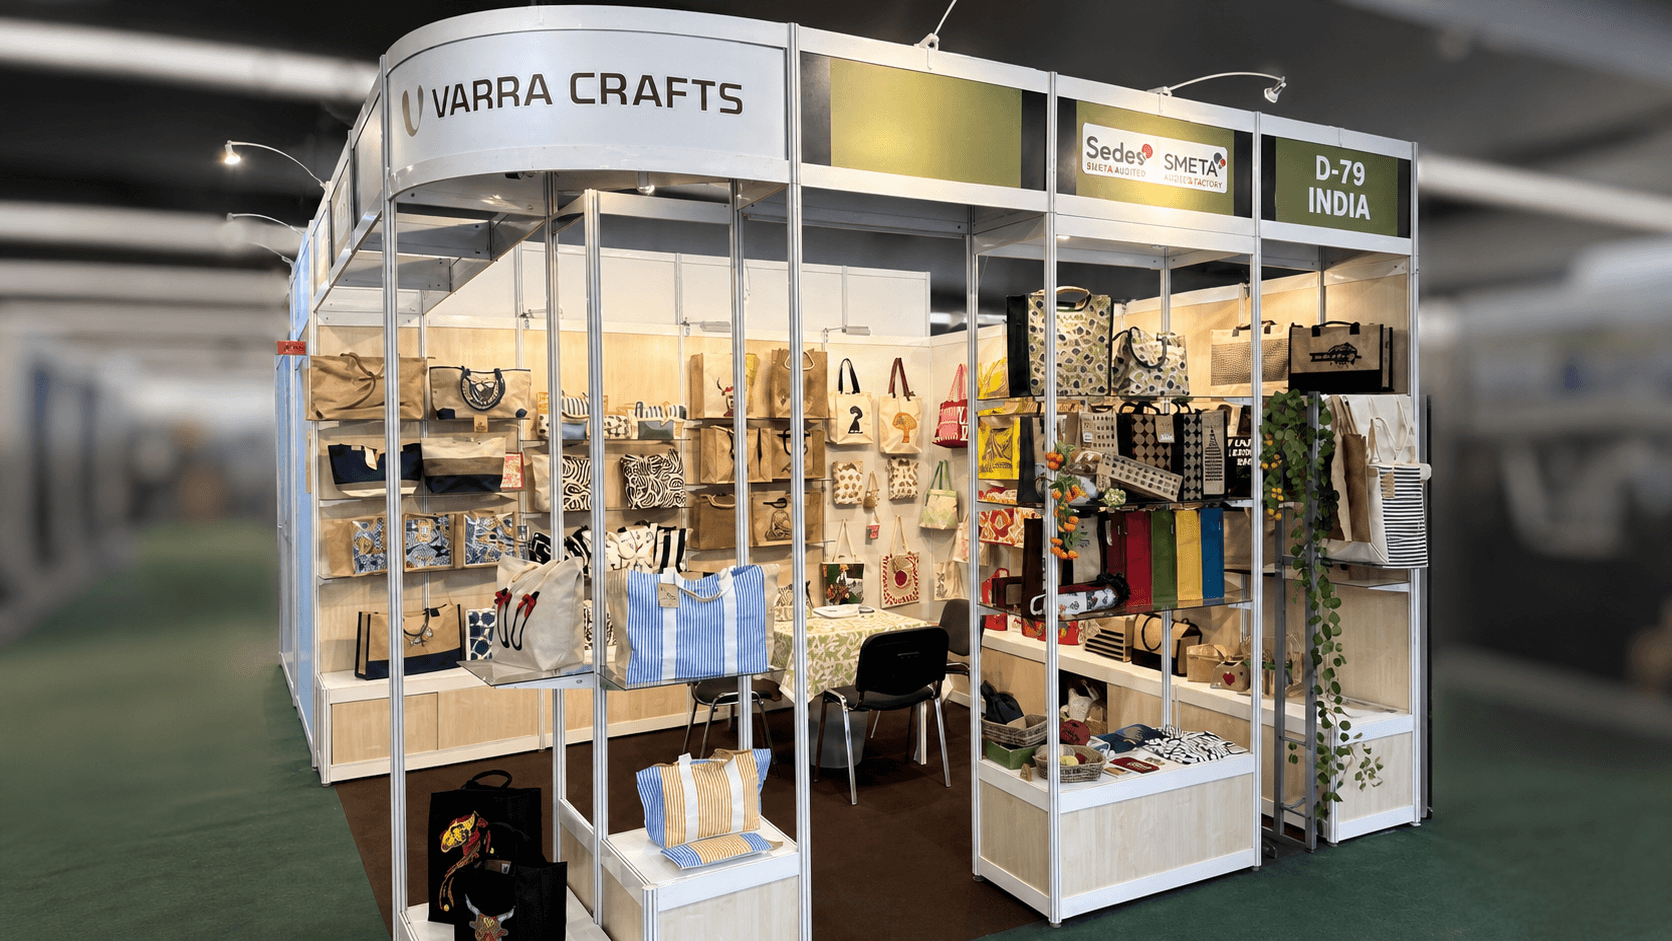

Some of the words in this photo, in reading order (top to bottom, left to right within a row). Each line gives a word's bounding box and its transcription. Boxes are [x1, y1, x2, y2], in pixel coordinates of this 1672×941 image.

[431, 73, 553, 119] VARRA
[570, 72, 743, 116] CRAFTS
[1086, 135, 1147, 166] Sedes
[1164, 153, 1218, 178] SMETA
[1315, 154, 1366, 187] D-79
[1308, 186, 1371, 220] INDIA
